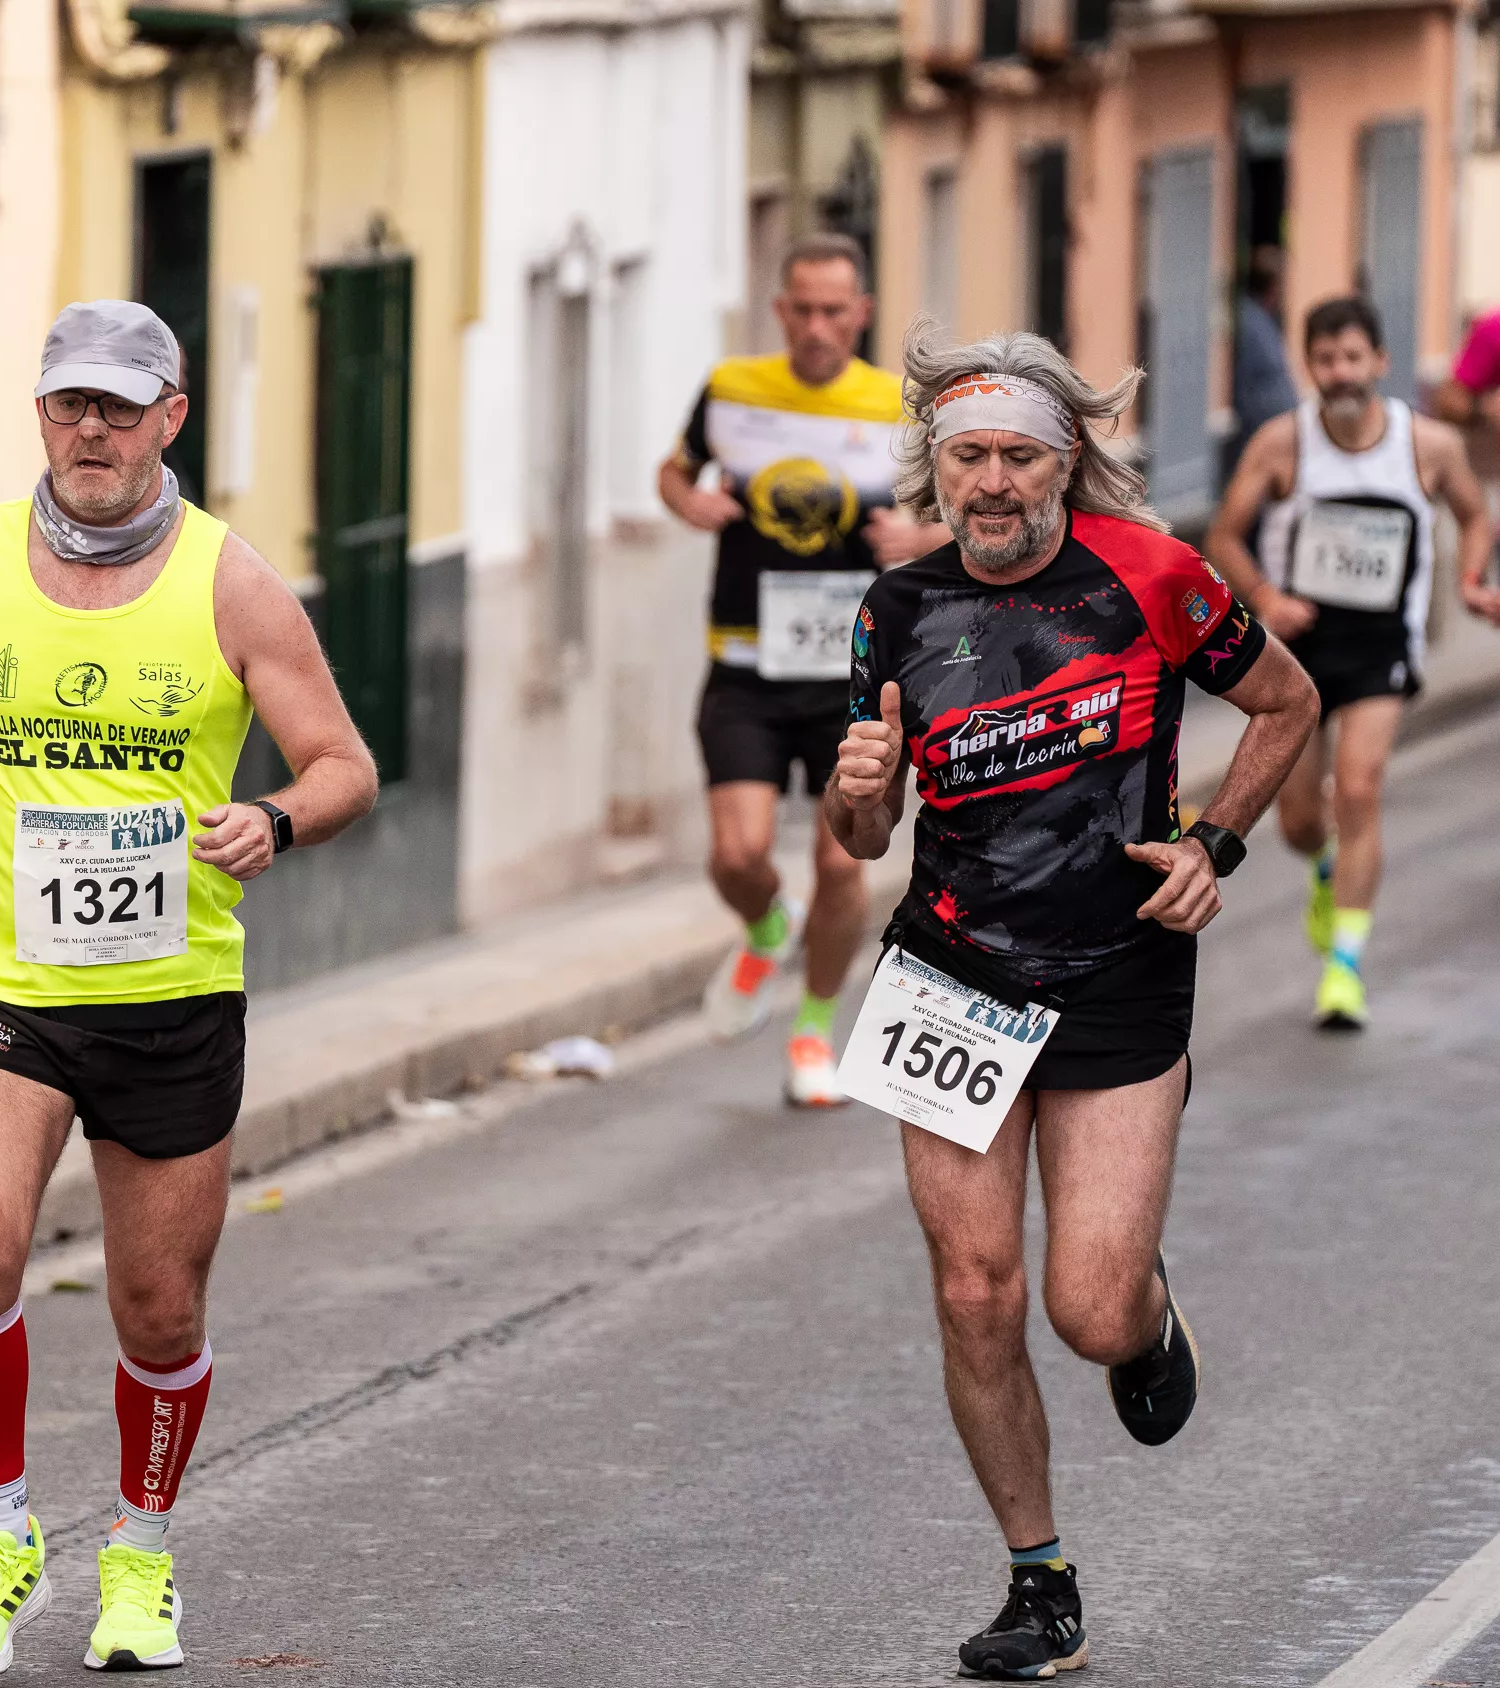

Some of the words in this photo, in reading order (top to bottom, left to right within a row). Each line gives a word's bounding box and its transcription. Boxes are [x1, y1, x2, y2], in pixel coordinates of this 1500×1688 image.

[131, 357, 151, 369] FORCLAZ
[138, 667, 182, 682] Salas
[20, 717, 104, 741] NOCTURNA
[108, 723, 126, 742] DE
[130, 725, 191, 747] VERANO
[43, 741, 186, 773] SANTO
[984, 754, 1006, 779] de
[1015, 733, 1077, 771] Lecrín
[21, 810, 52, 821] CIRCUITO
[53, 813, 97, 822] PROVINCIAL
[98, 814, 108, 822] DE
[21, 819, 60, 829] CARRERAS
[61, 821, 108, 830] POPULARES
[111, 811, 155, 829] 2024
[60, 857, 75, 865] XXV
[89, 857, 115, 865] CIUDAD
[126, 853, 151, 862] LUCENA
[100, 865, 136, 874] IGUALDAD
[40, 871, 164, 926] 1321
[71, 936, 96, 944] MARÍA
[97, 934, 134, 943] CÓRDOBA
[134, 930, 158, 939] LUQUE
[927, 981, 937, 990] DE
[931, 975, 976, 1001] POPULARES
[912, 1005, 927, 1014] XXV
[938, 1015, 963, 1030] CIUDAD
[962, 1024, 973, 1034] DE
[971, 1029, 997, 1046] LUCENA
[921, 1018, 934, 1029] POR
[934, 1024, 944, 1033] LA
[943, 1028, 978, 1047] IGUALDAD
[881, 1021, 1003, 1106] 1506
[885, 1081, 903, 1093] JUAN
[902, 1088, 919, 1100] PINO
[918, 1095, 956, 1115] CORRALES
[178, 1401, 187, 1427] TECHNOLOGY
